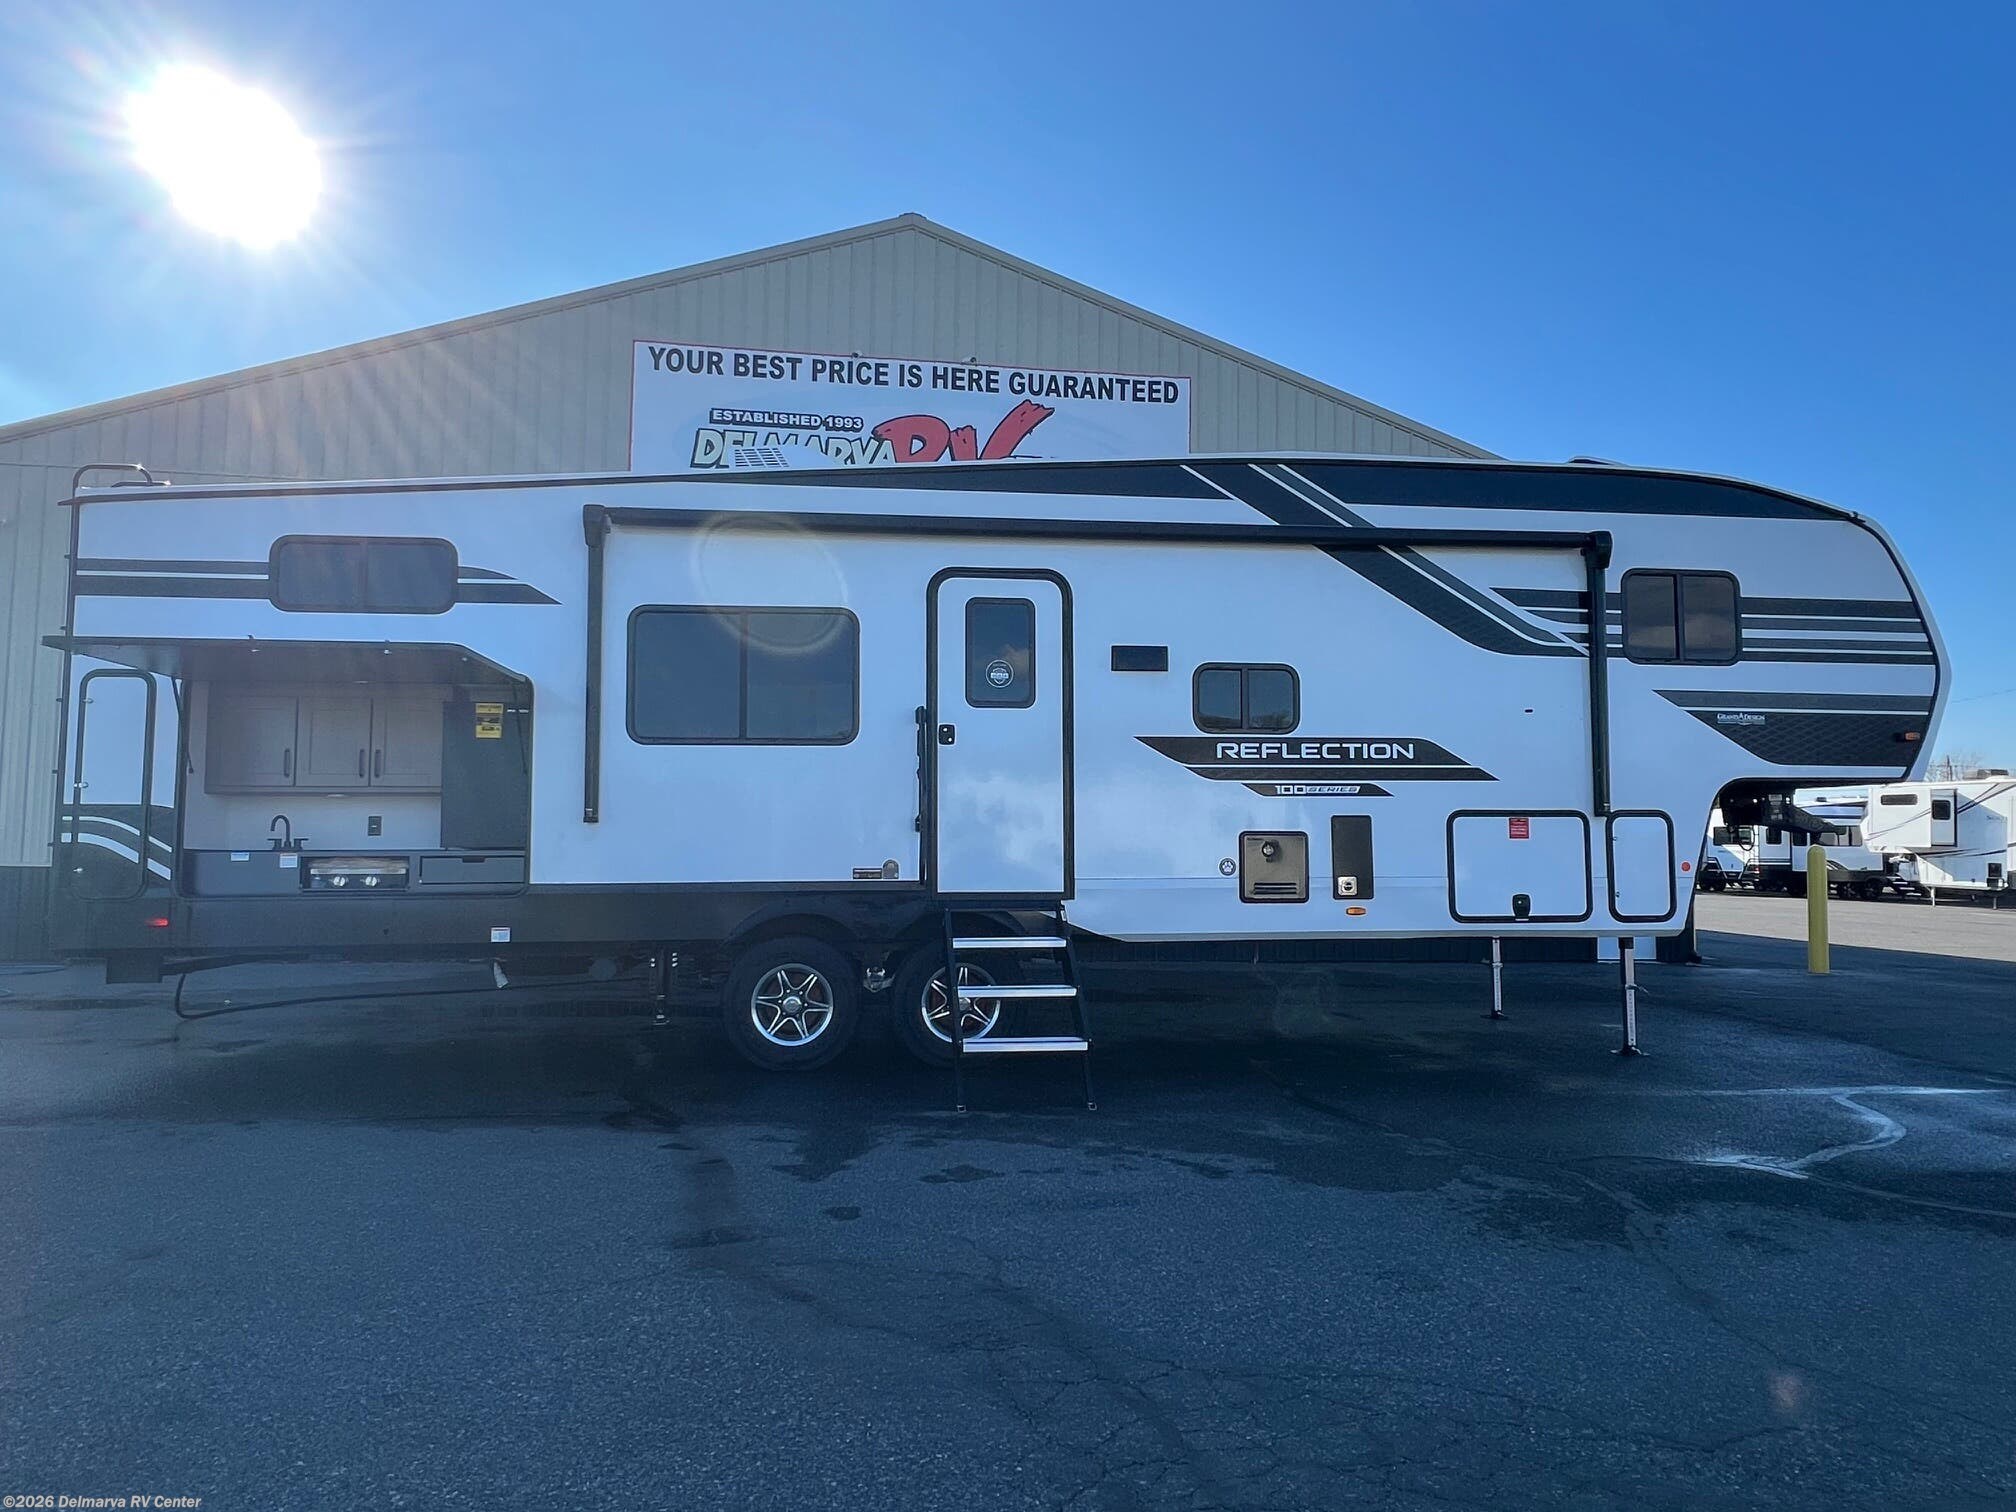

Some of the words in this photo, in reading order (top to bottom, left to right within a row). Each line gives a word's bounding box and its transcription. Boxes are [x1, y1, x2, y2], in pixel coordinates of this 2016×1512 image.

[648, 346, 724, 376] YOUR
[733, 353, 803, 381] BEST
[811, 358, 889, 386] PRICE
[899, 364, 923, 388] IS
[932, 365, 1000, 394] HERE
[1008, 371, 1179, 404] GUARANTEED
[711, 408, 822, 429] ESTABLISHED
[825, 415, 863, 431] 1993
[1216, 742, 1415, 760] REFLECTION
[1275, 785, 1306, 794] 100
[1307, 785, 1359, 794] SERIES
